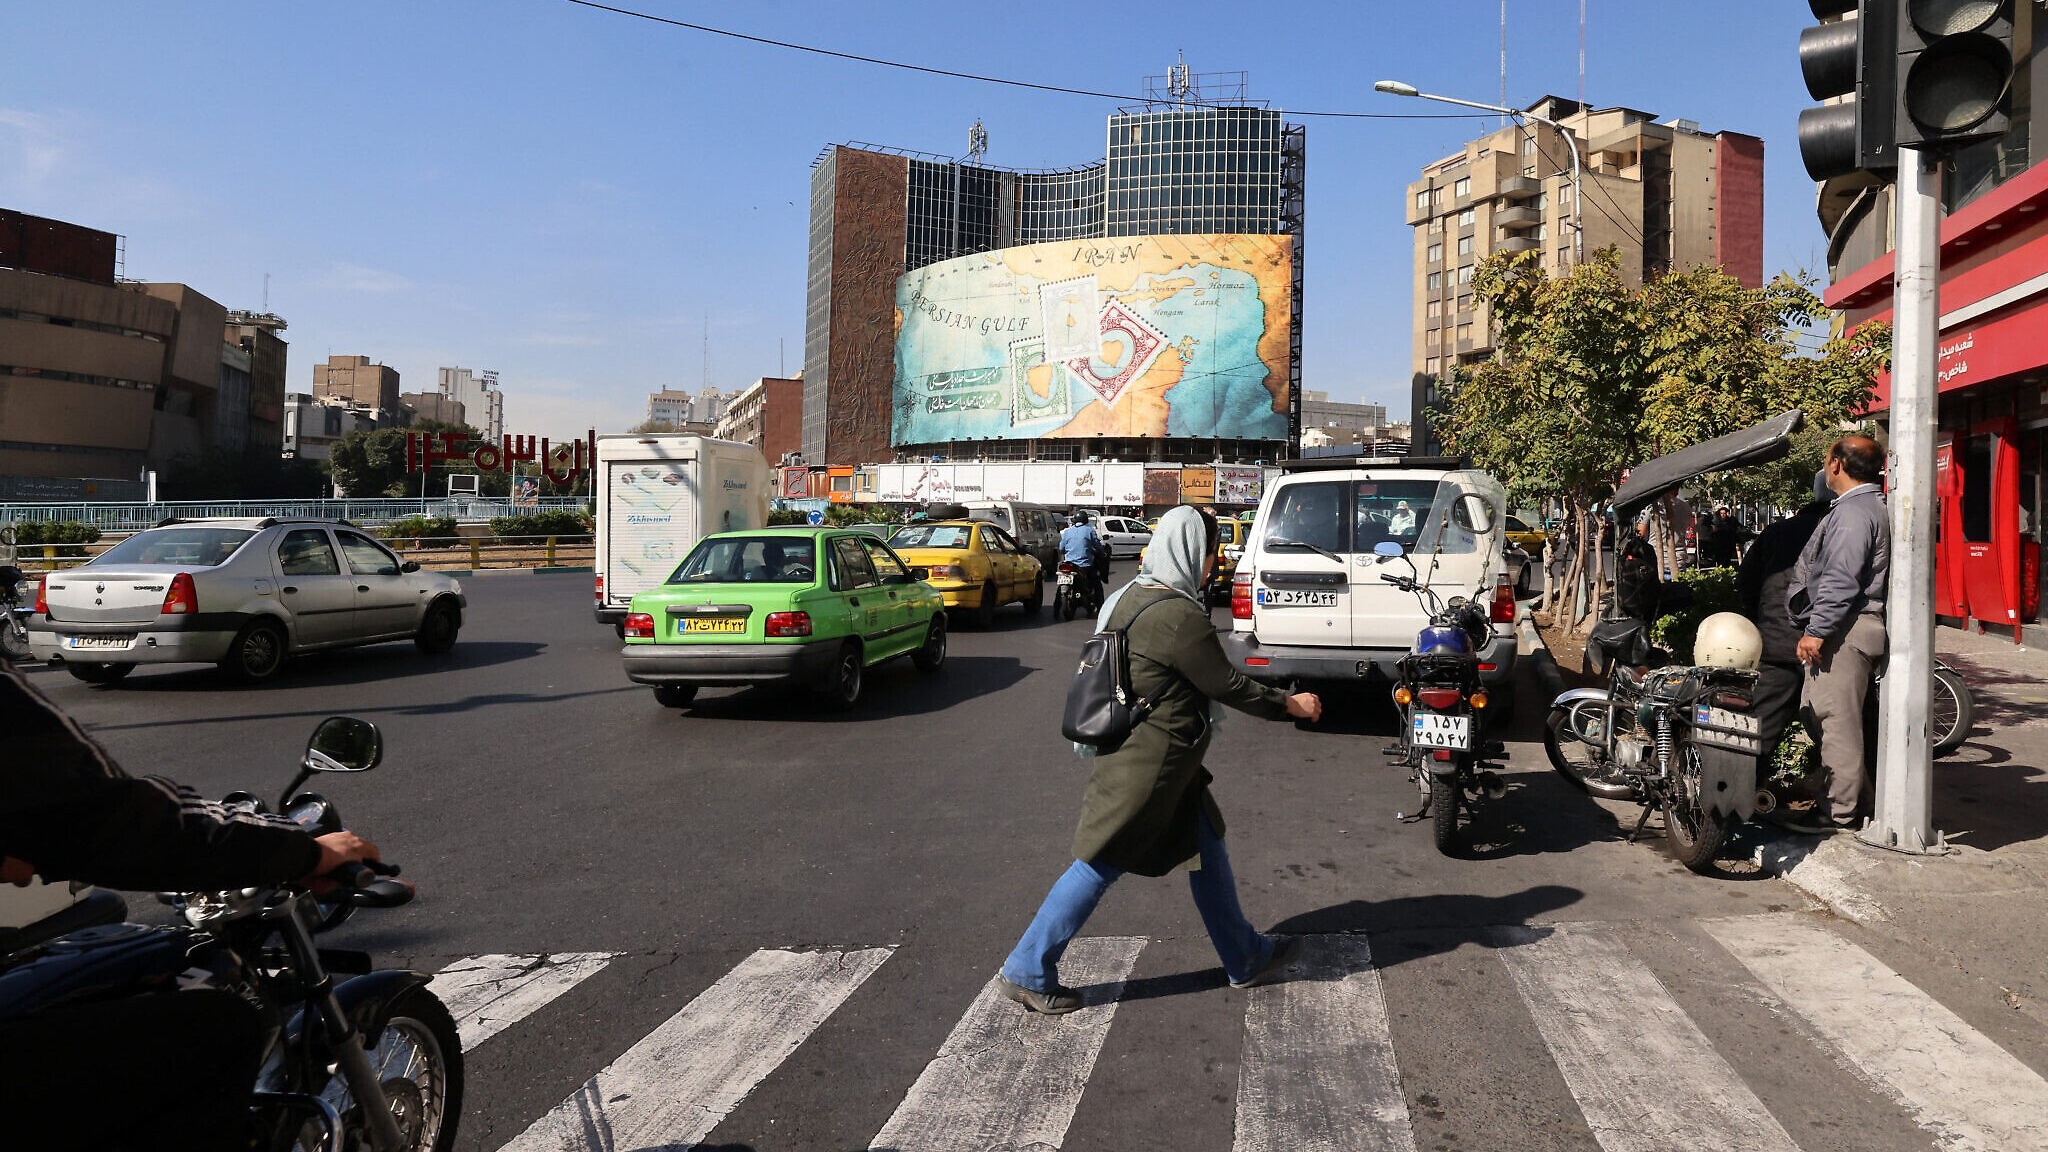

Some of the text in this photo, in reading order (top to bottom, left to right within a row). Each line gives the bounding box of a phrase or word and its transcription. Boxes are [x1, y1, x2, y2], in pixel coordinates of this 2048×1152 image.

[1071, 243, 1143, 268] IRAN
[1208, 281, 1246, 290] Hormoz
[1194, 298, 1221, 307] Larak
[911, 289, 1030, 336] PERSIAN GULF
[1153, 308, 1184, 317] Hengam
[1954, 332, 1974, 356] شعبه
[1220, 470, 1237, 480] فود
[1238, 470, 1258, 479] فست
[1228, 483, 1249, 494] آرام
[1432, 716, 1462, 731] ۱۵۷
[1415, 731, 1467, 748] ۲۹۵۴۷
